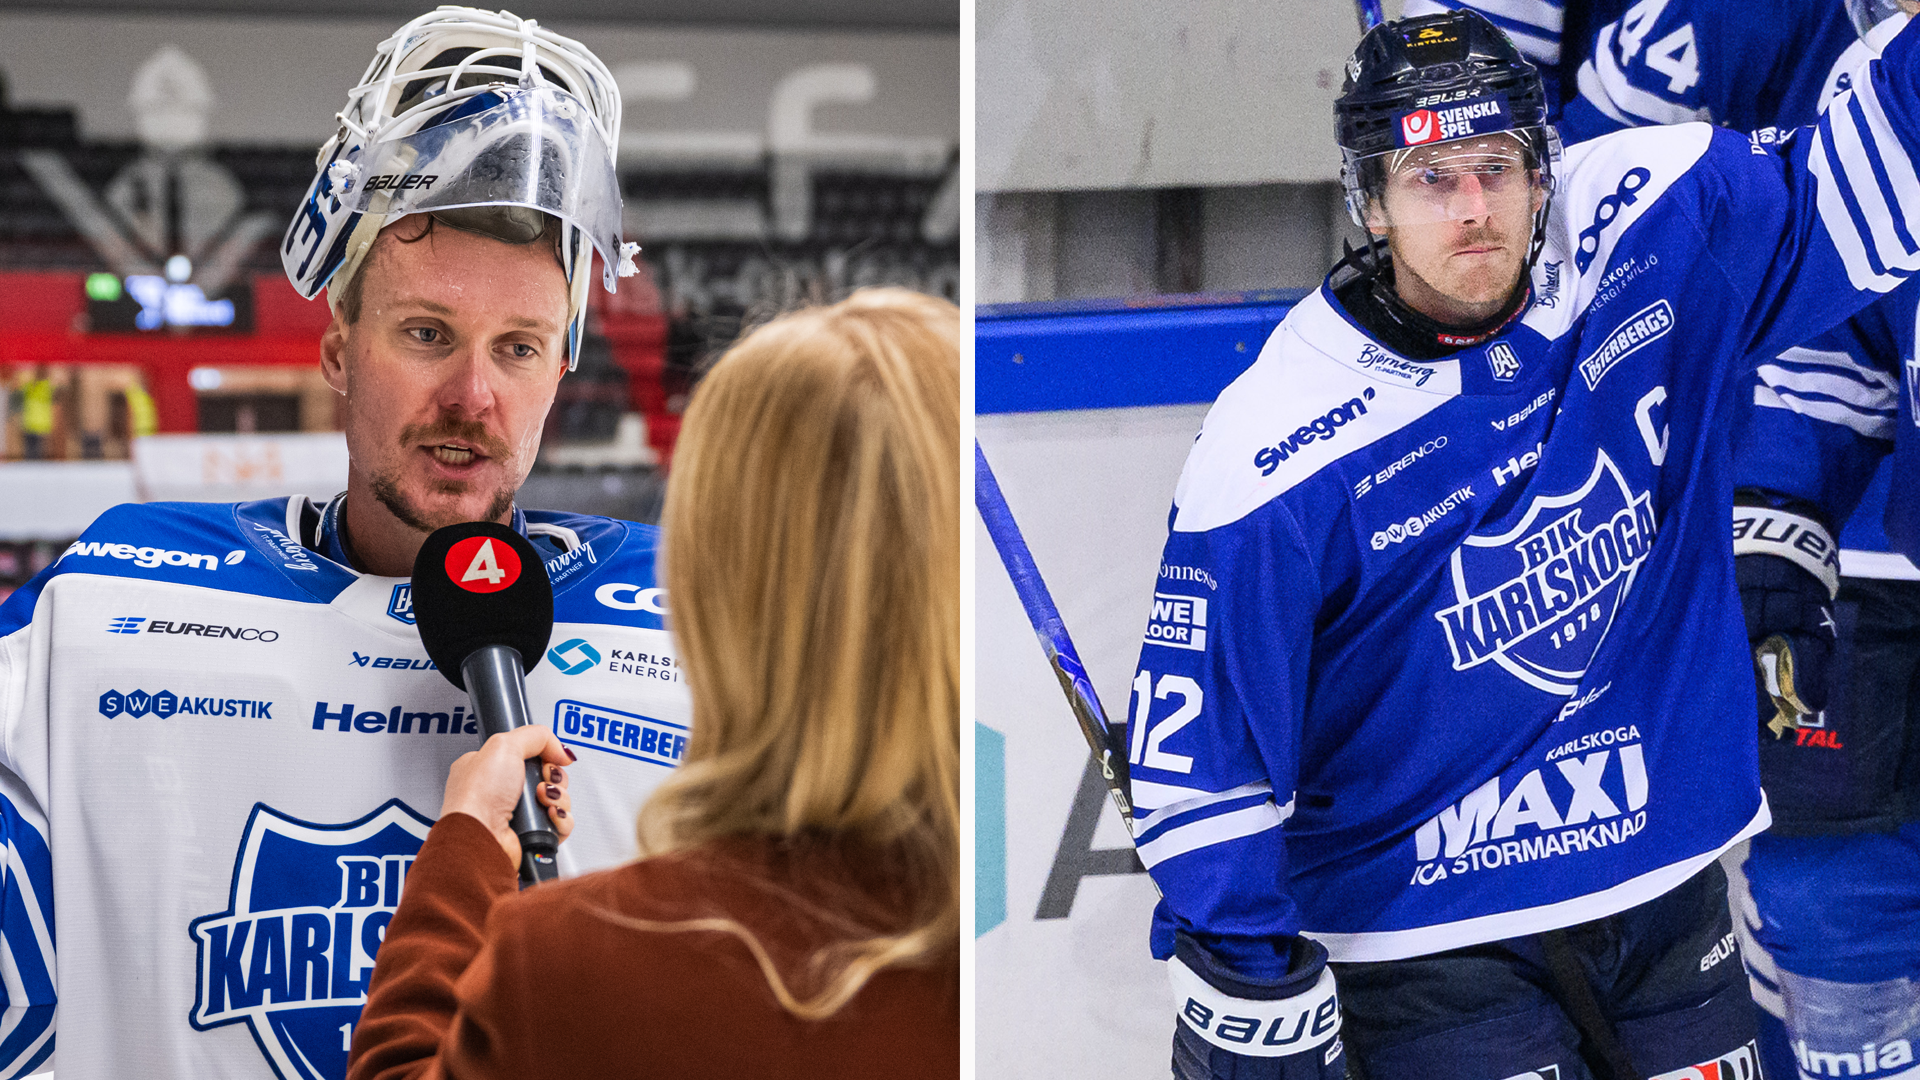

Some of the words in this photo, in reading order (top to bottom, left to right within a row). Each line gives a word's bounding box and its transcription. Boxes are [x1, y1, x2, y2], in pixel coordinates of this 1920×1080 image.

[1619, 0, 1700, 94] 44
[1437, 101, 1501, 125] SVENSKA
[1440, 121, 1474, 139] SPEL
[1589, 282, 1622, 315] NERGI
[1357, 343, 1437, 387] Björnberg
[1586, 308, 1670, 382] ÖSTERBERGS
[1253, 396, 1368, 477] Swegon
[1634, 386, 1670, 466] C
[1375, 436, 1448, 485] EURENCO
[461, 538, 506, 584] 4
[1521, 510, 1584, 570] BIK
[1733, 517, 1841, 574] AUER
[1442, 501, 1656, 665] KARLSKOGA
[147, 620, 279, 643] EURENCO
[1145, 624, 1189, 641] OOR
[1150, 600, 1191, 624] WE
[1550, 603, 1601, 649] 1978
[371, 656, 438, 670] BAU
[609, 661, 677, 683] ENERGI
[563, 704, 688, 760] ÖSTERBER
[1129, 669, 1204, 774] 12
[1545, 724, 1641, 761] KARLSKOGA
[1415, 743, 1649, 861] MAXI
[1410, 863, 1448, 886] ICA
[1451, 811, 1648, 875] STORMARKNAD
[341, 859, 416, 908] BI
[203, 910, 396, 1018] KARLS
[1184, 994, 1341, 1046] BAUE
[1791, 1038, 1914, 1077] lmia
